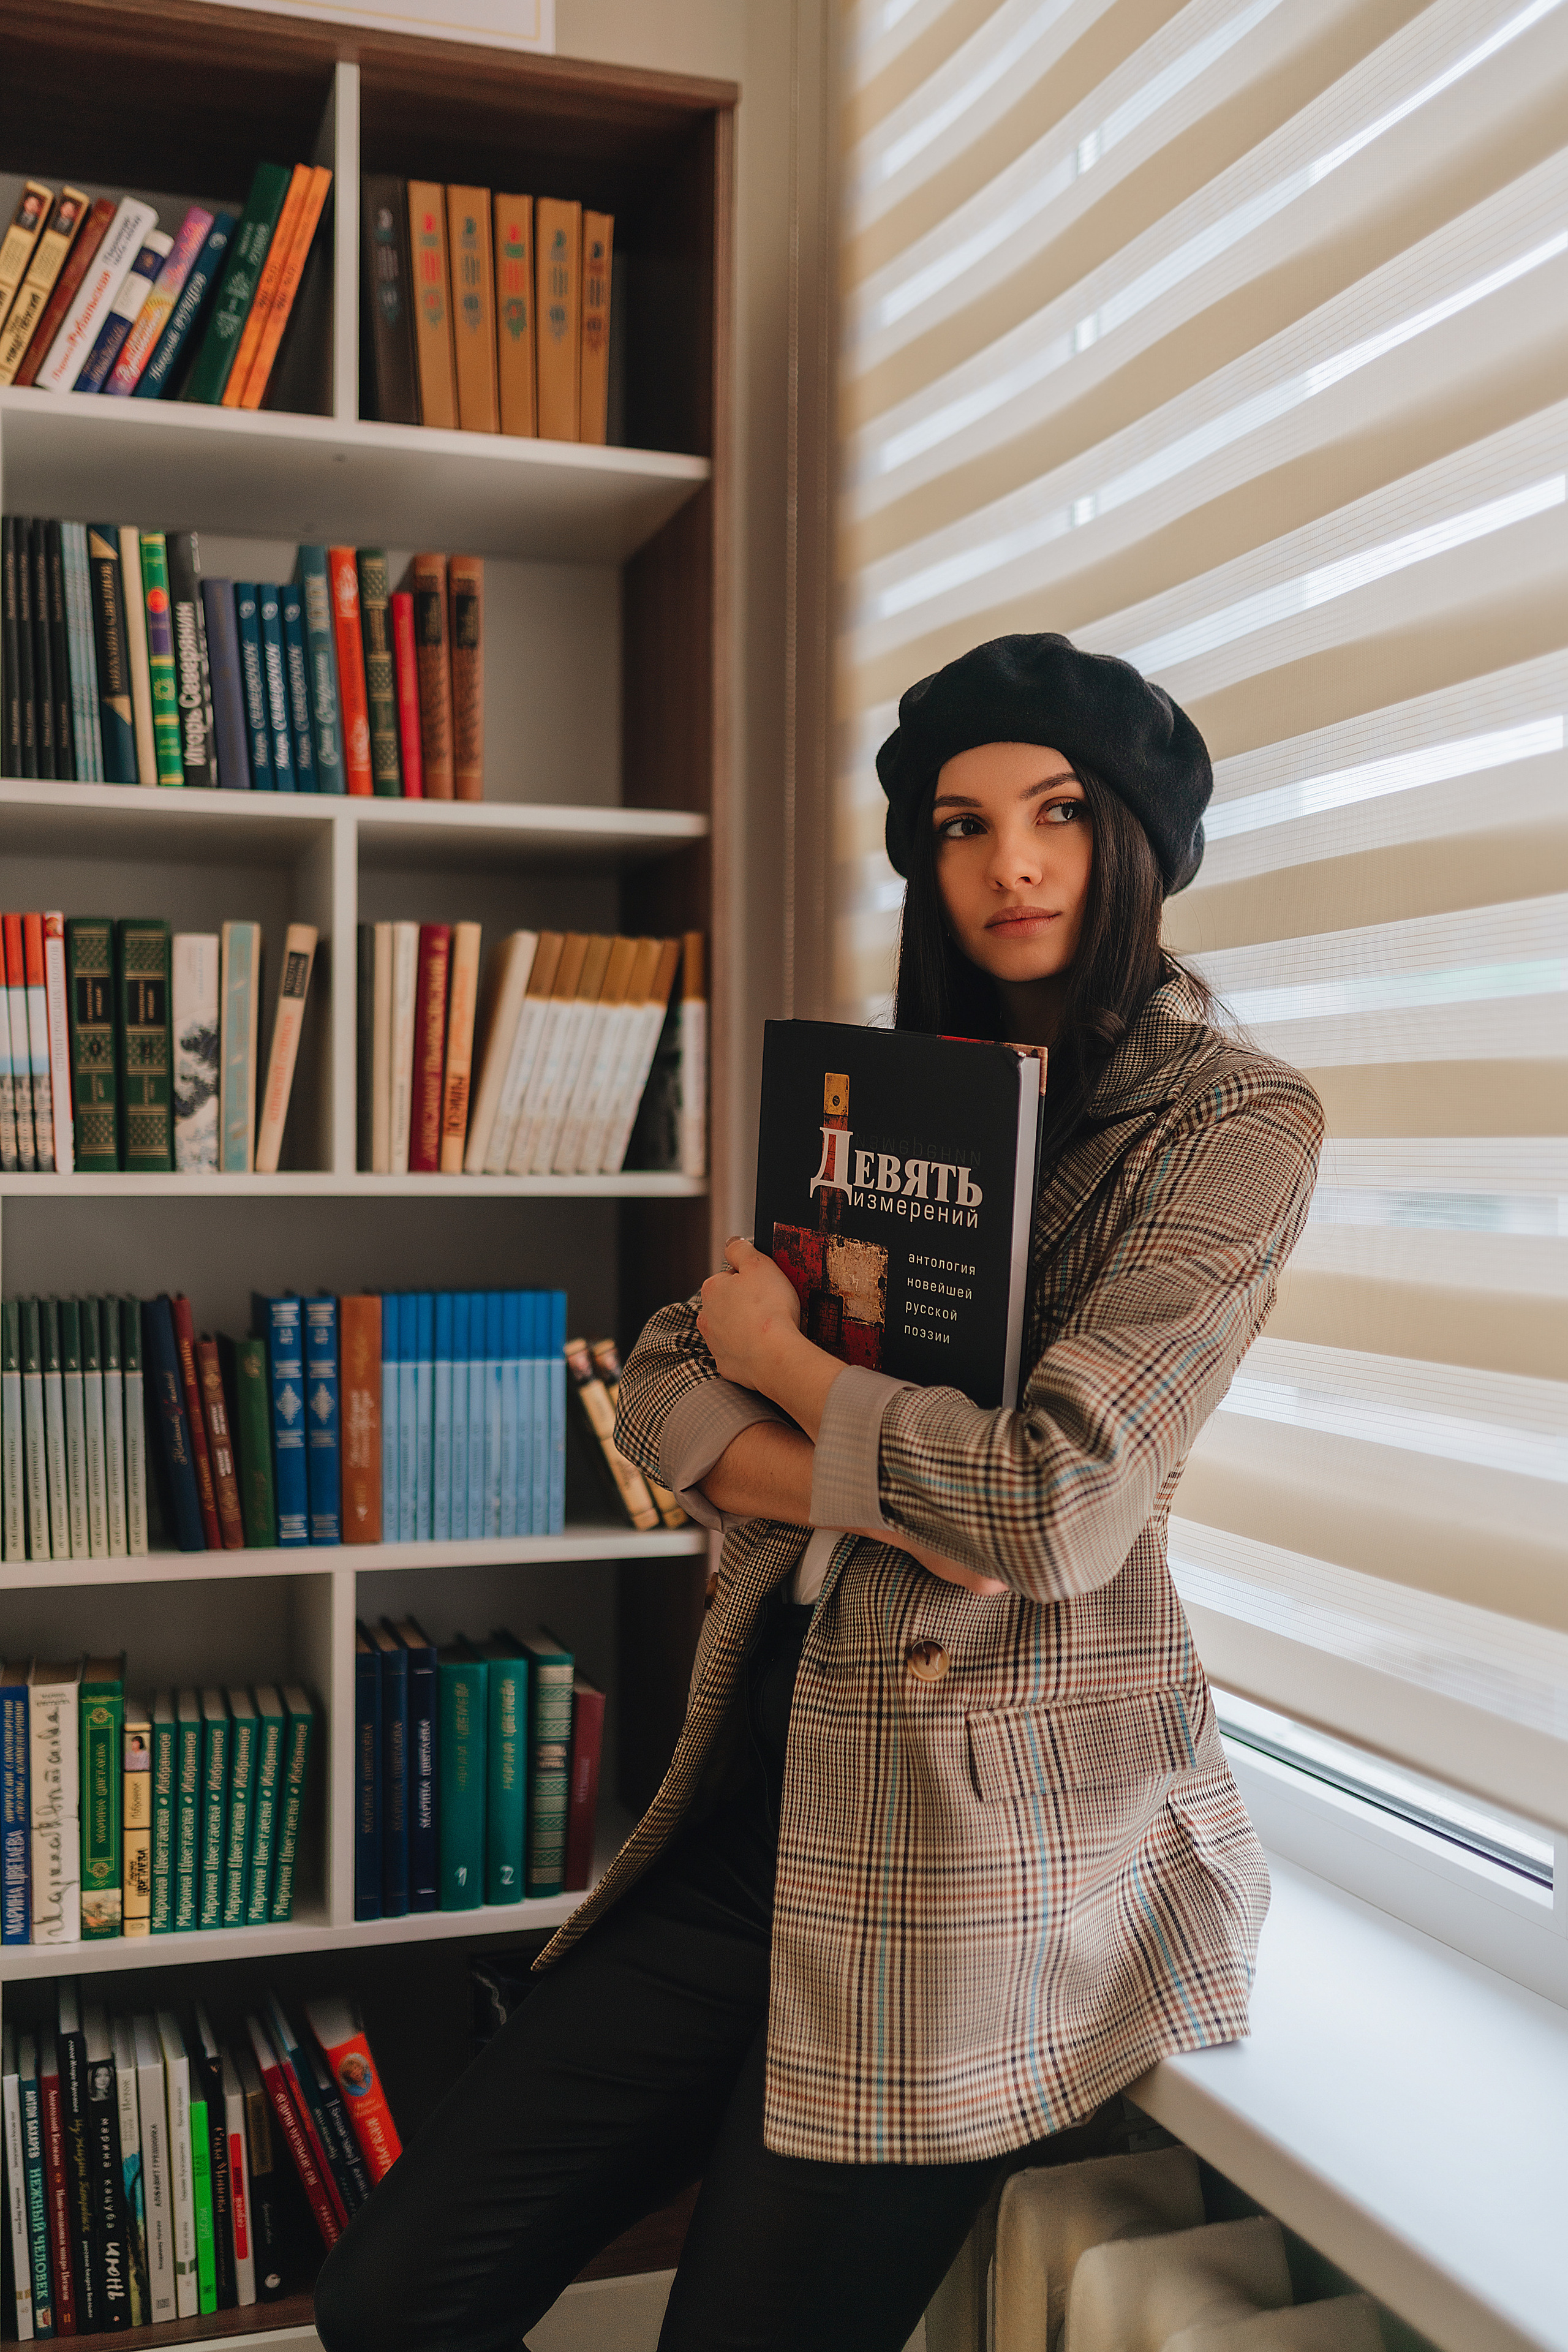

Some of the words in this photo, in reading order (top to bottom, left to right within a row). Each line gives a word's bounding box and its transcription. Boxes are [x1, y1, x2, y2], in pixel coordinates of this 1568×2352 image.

[170, 600, 206, 709] Северянин
[179, 707, 211, 767] Игорь
[854, 1191, 978, 1229] измерений
[907, 1277, 972, 1300] новейшей
[908, 1253, 976, 1276] антология
[904, 1325, 949, 1344] поэзии
[905, 1301, 957, 1321] русской
[95, 1742, 107, 1796] ЦВЕТАЕВА
[154, 1732, 173, 1795] Избранное
[180, 1730, 199, 1793] Избранное
[206, 1728, 226, 1790] Избранное
[232, 1725, 252, 1789] Избранное
[258, 1724, 281, 1787] Избранное
[286, 1721, 309, 1784] Избранное
[360, 1722, 374, 1781] ЦВЕТАЕВА
[390, 1719, 403, 1779] ЦВЕТАЕВА
[417, 1718, 433, 1777] ЦВЕТАЕВА
[96, 1798, 106, 1842] МАРИНА
[361, 1785, 374, 1834] МАРИНА
[390, 1782, 403, 1831] МАРИНА
[417, 1779, 432, 1828] МАРИНА
[153, 1807, 170, 1875] Цветаева
[176, 1806, 196, 1874] Цветаева
[202, 1804, 222, 1871] Цветаева
[226, 1801, 247, 1869] Цветаева
[251, 1800, 273, 1866] Цветаева
[277, 1796, 300, 1864] Цветаева
[4, 1828, 29, 1885] ЦВЕТАЕВА
[135, 1846, 150, 1897] ЦВЕТАЕВА
[453, 1865, 467, 1887] 1
[499, 1864, 514, 1885] 2
[4, 1886, 24, 1936] МАРИНА
[152, 1876, 172, 1928] Марина
[175, 1874, 196, 1926] Марина
[200, 1872, 221, 1924] Марина
[224, 1869, 245, 1921] Марина
[247, 1867, 270, 1919] Марина
[273, 1864, 295, 1916] Марина
[24, 2089, 39, 2119] АНТОН
[25, 2119, 42, 2159] БАХАРЕВ
[71, 2136, 86, 2177] жизни
[96, 2117, 113, 2168] марина
[28, 2166, 47, 2234] НЕЖНЫЙ
[99, 2178, 118, 2230] кацуба
[32, 2234, 49, 2301] ЧЕЛОВЕК
